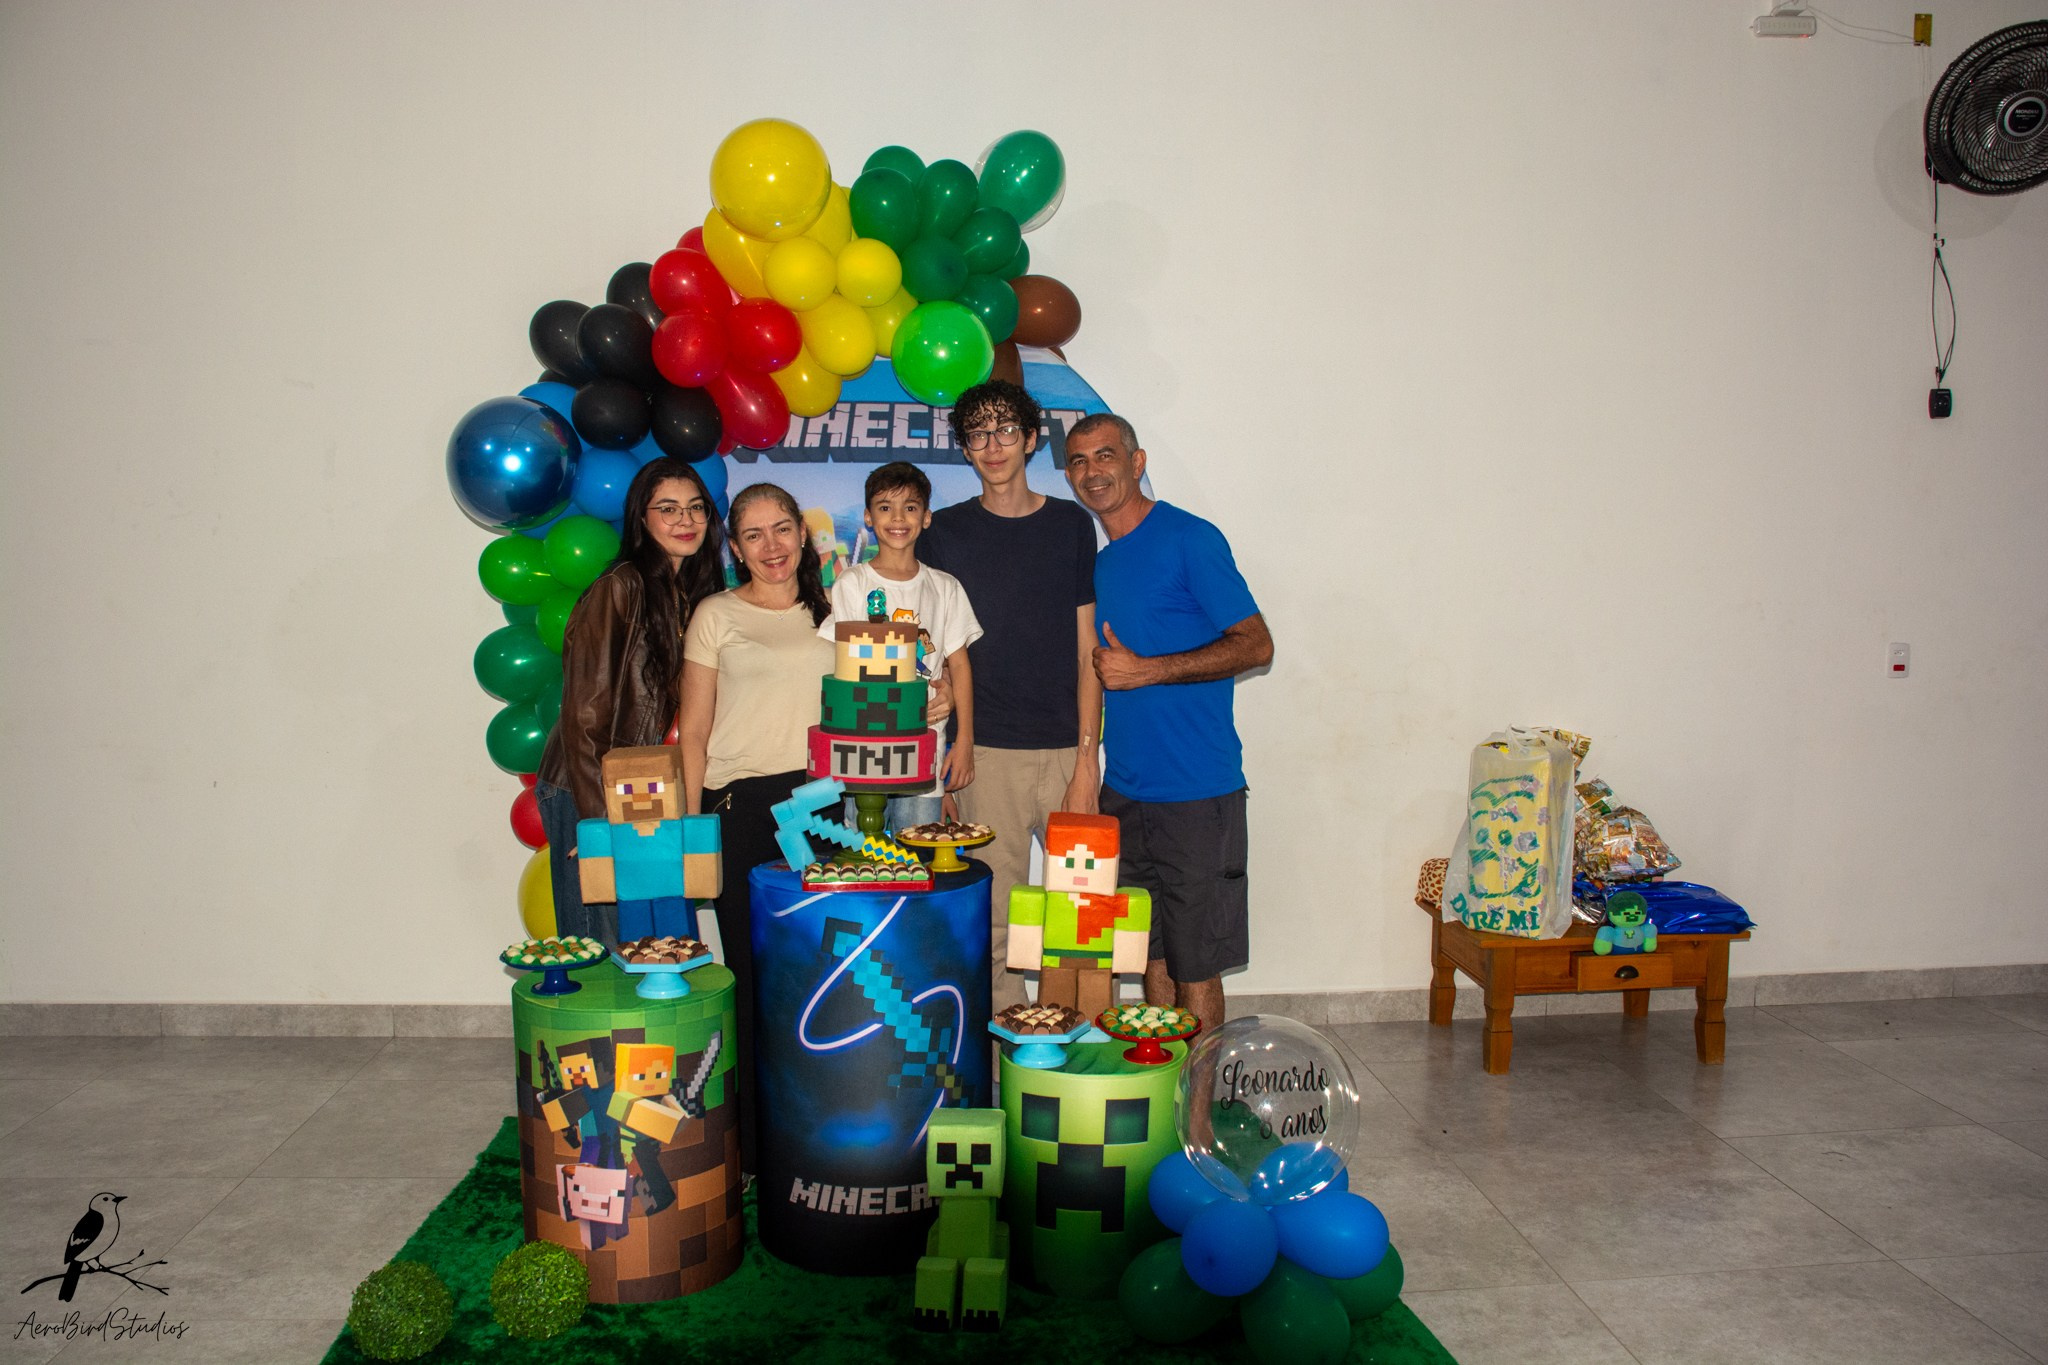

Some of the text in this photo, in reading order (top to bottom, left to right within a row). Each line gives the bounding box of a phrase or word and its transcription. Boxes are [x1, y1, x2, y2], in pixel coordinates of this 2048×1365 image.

[833, 743, 917, 775] TNT
[1220, 1059, 1331, 1110] Leonardo
[1281, 1104, 1329, 1139] anos
[789, 1176, 941, 1216] MINECR
